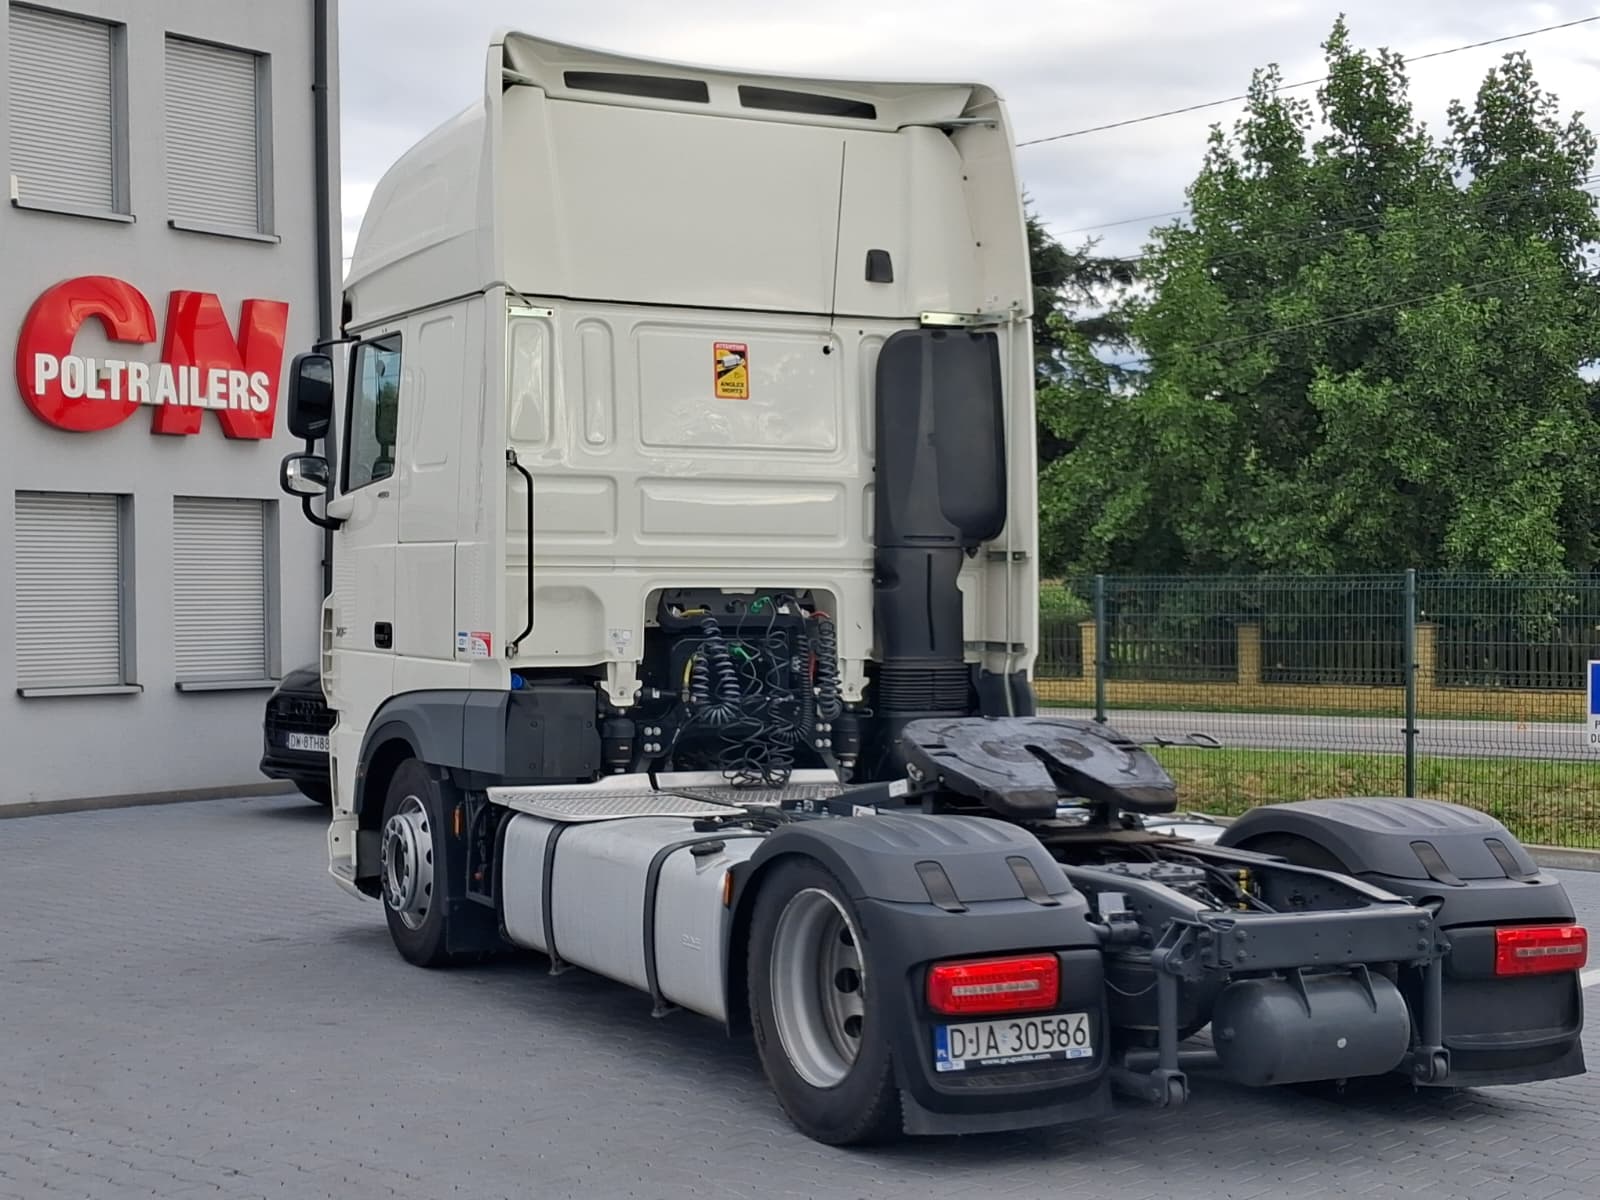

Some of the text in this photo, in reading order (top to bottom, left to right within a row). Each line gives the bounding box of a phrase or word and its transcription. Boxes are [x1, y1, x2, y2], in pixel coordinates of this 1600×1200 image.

[15, 275, 289, 439] CN
[34, 353, 270, 412] POLTRAILERS
[950, 1016, 1087, 1058] DJA 30586
